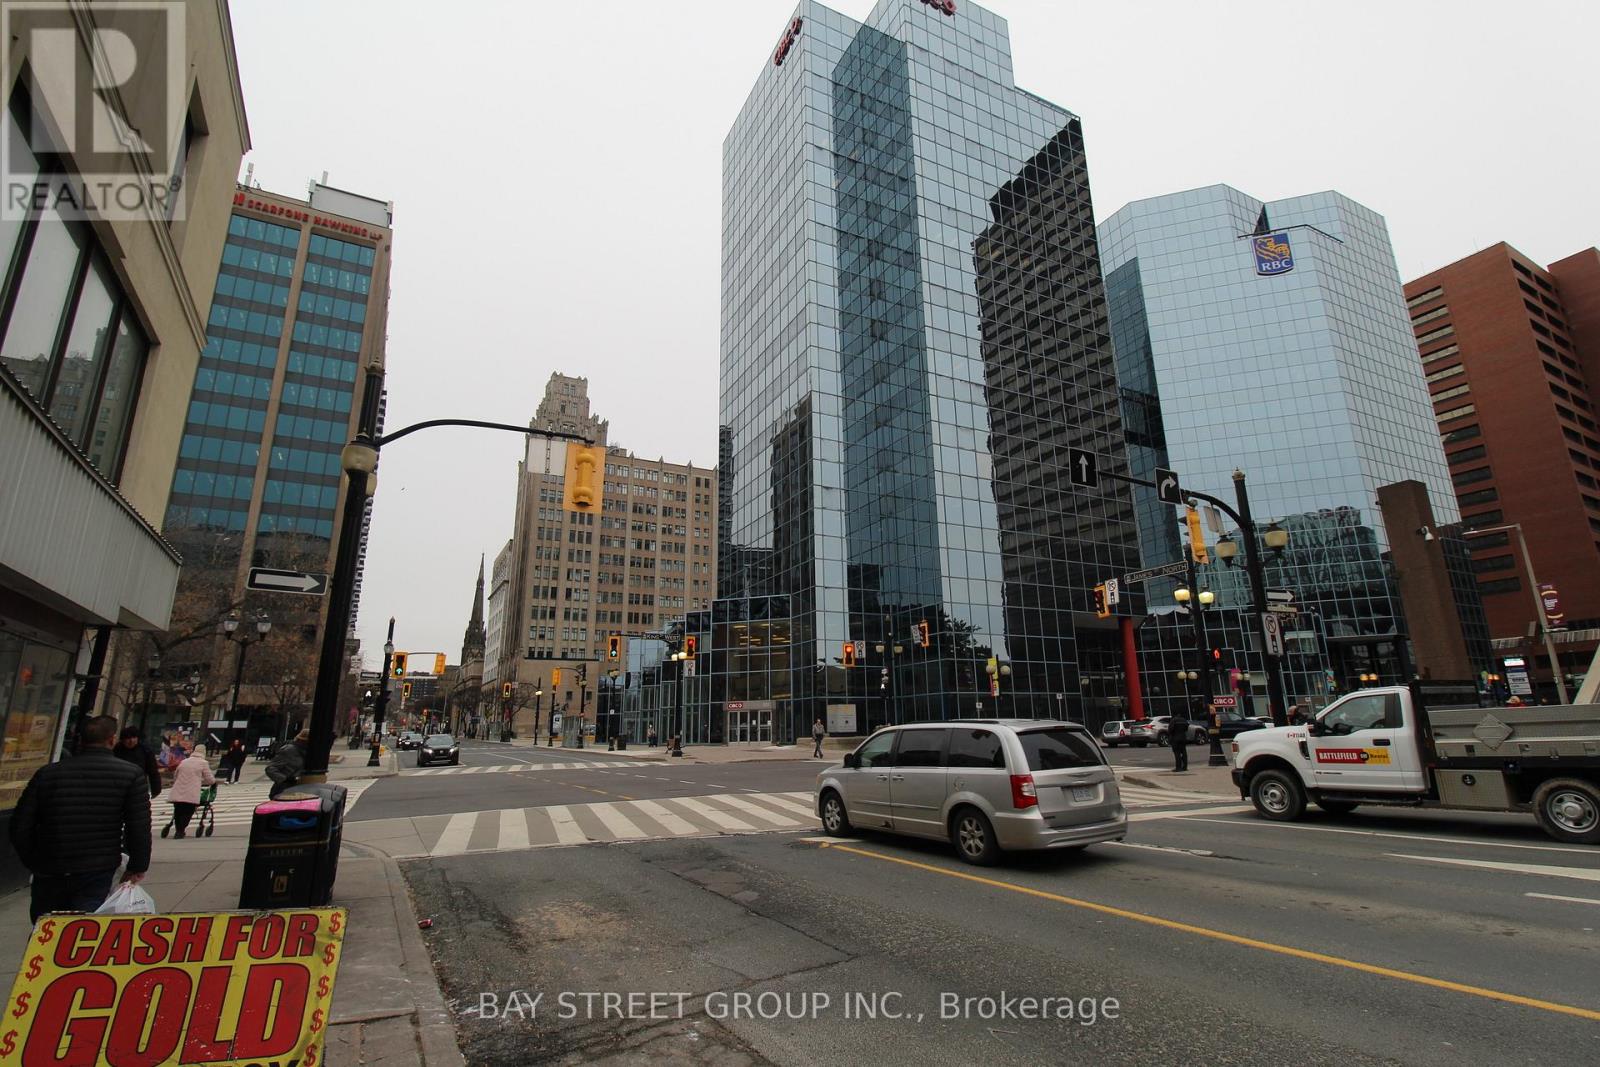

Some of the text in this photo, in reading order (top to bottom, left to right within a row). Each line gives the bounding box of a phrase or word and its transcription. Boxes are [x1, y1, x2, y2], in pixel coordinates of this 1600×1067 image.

[247, 199, 309, 223] SCARFONE
[313, 215, 369, 237] HAWKINS
[369, 232, 383, 241] LLP
[1261, 258, 1291, 271] RBC
[1162, 563, 1187, 575] NORTH
[664, 633, 680, 641] WEST
[1318, 751, 1358, 760] BATTLEFIELD
[53, 916, 214, 968] CASH
[219, 913, 319, 961] FOR
[21, 962, 311, 1067] GOLD
